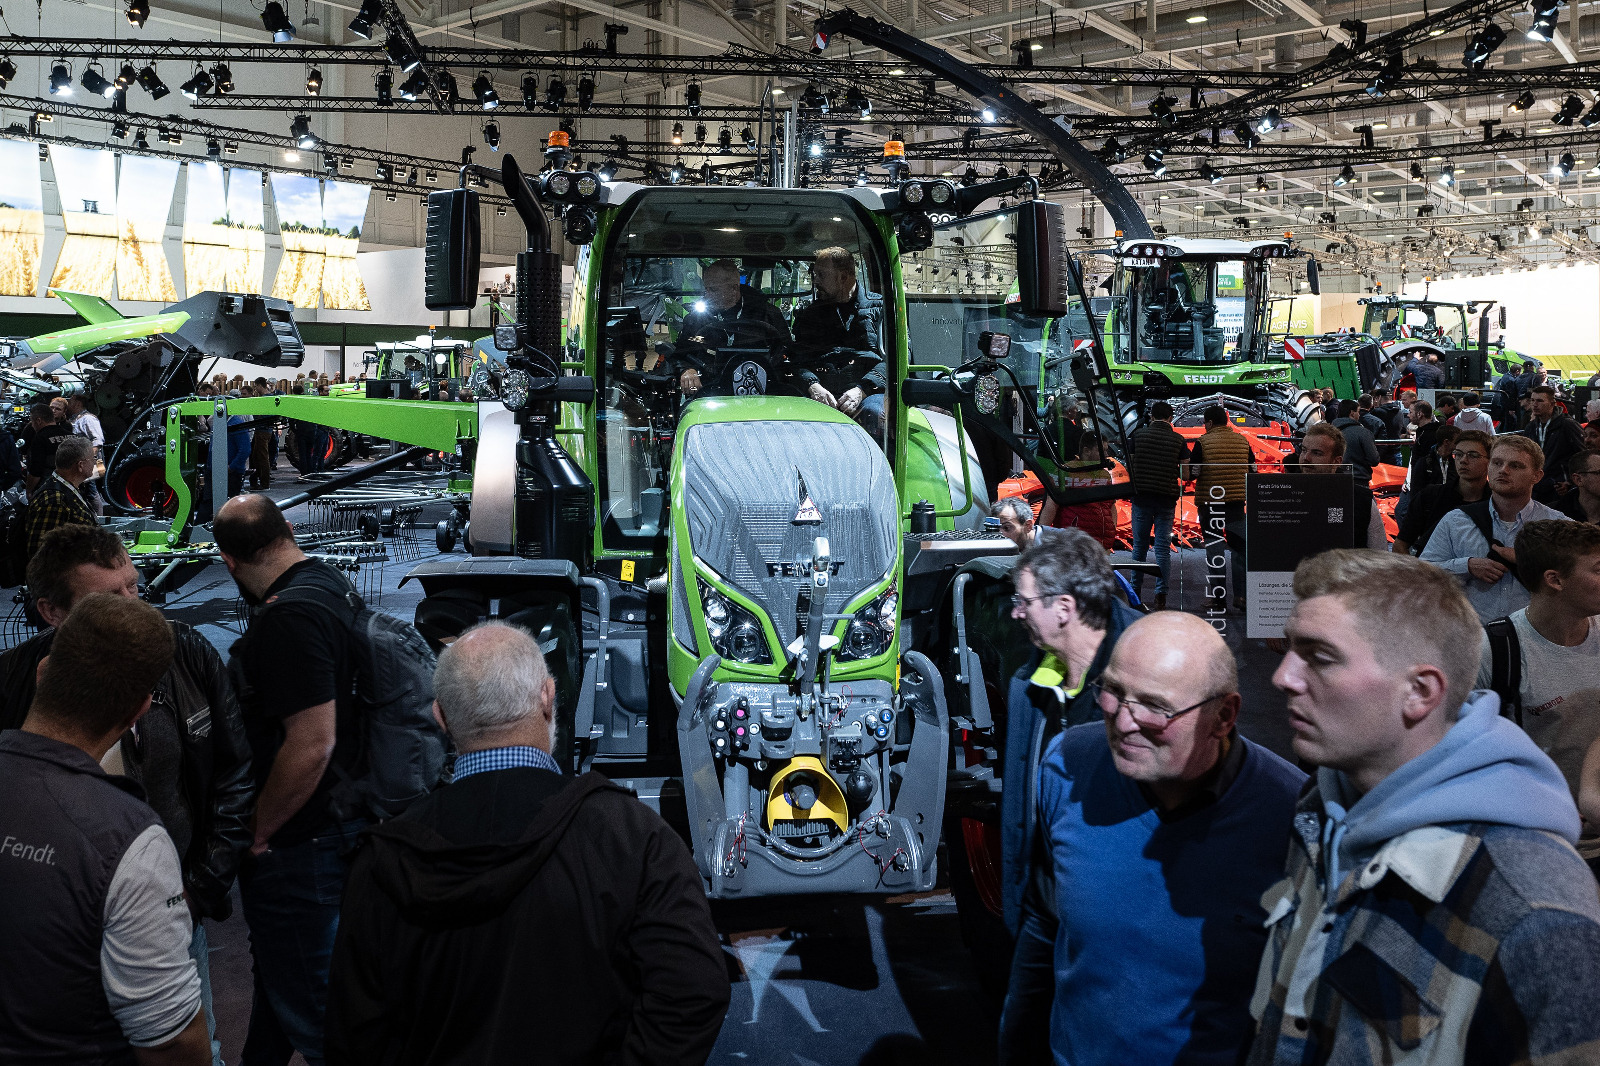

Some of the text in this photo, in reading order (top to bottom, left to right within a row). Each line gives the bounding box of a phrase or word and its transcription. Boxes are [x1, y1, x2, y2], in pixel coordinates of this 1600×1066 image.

[1271, 320, 1308, 330] AGRAVIS
[1184, 374, 1226, 384] FENDT
[1204, 485, 1226, 547] Vario
[765, 561, 846, 578] FENT
[1205, 554, 1227, 599] 516
